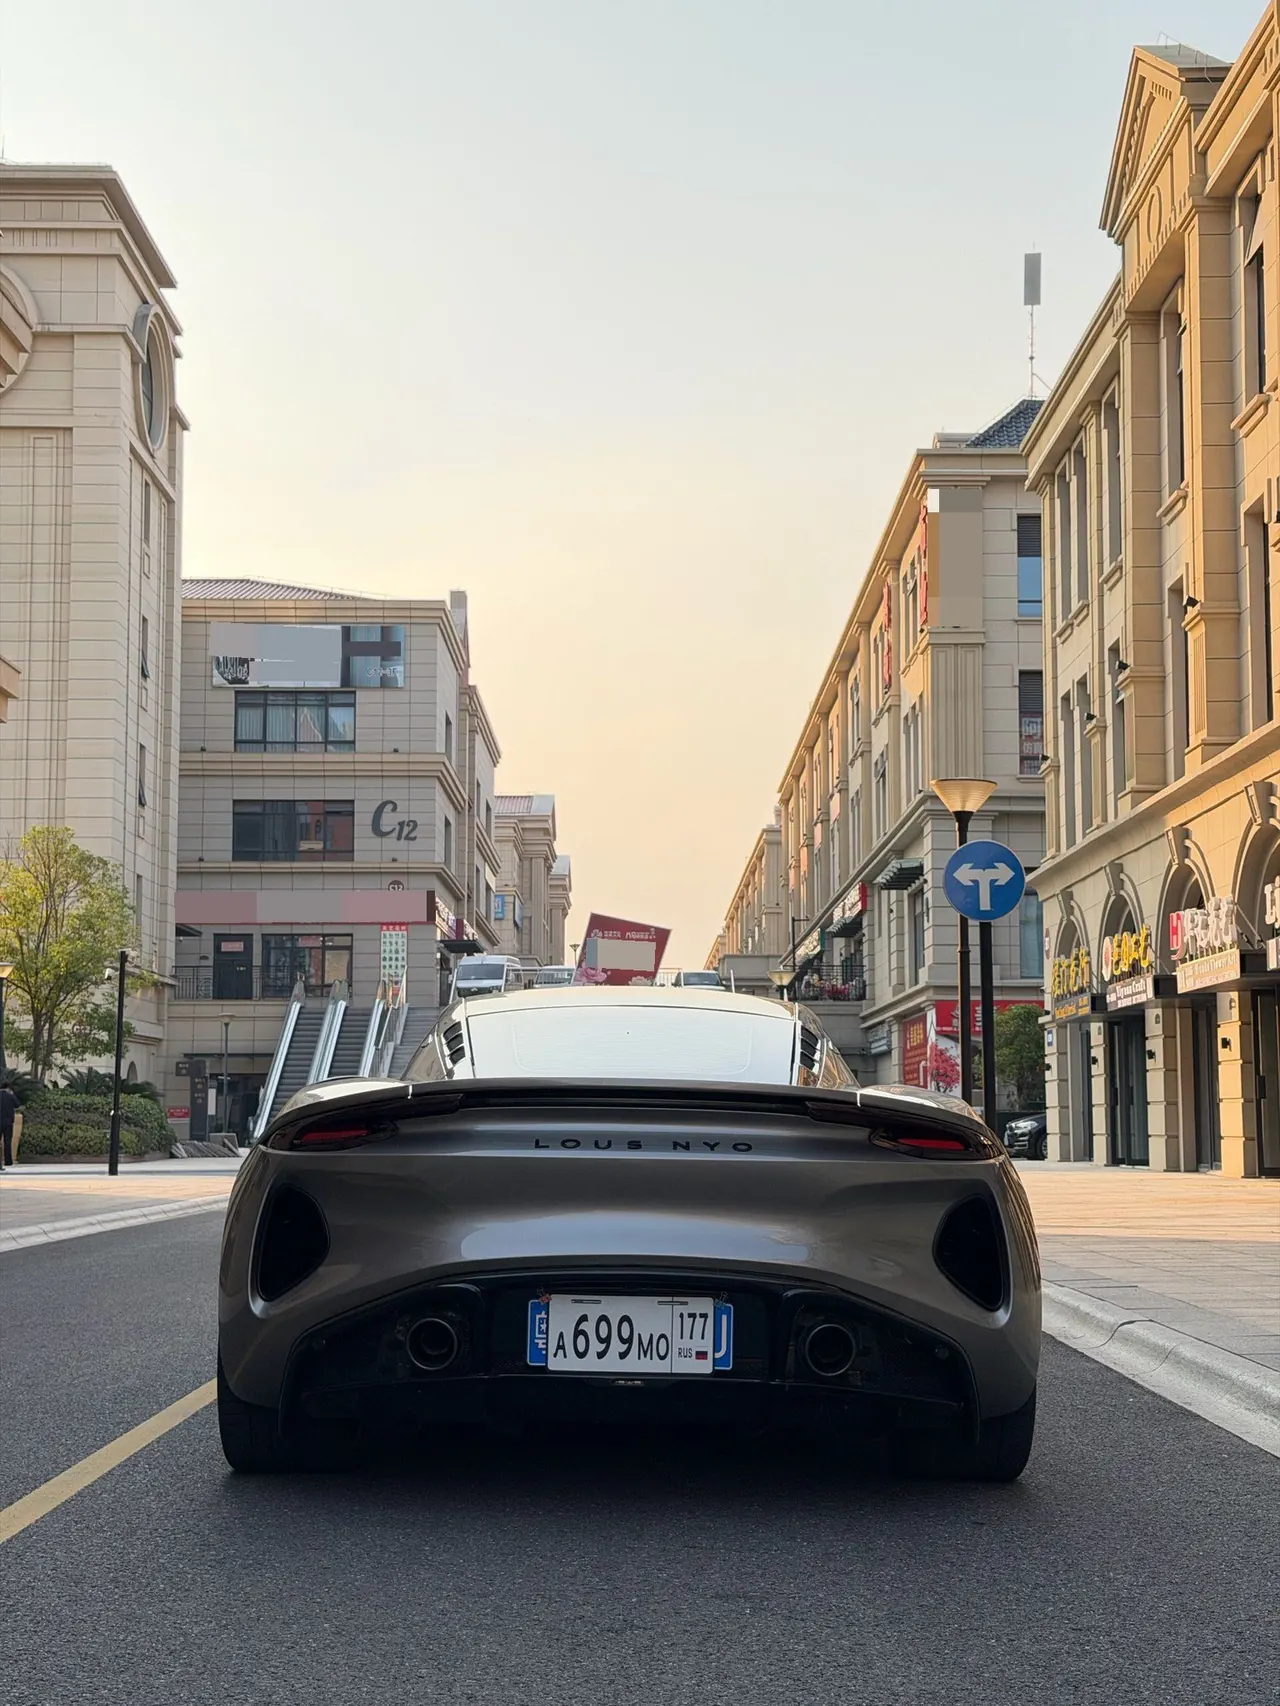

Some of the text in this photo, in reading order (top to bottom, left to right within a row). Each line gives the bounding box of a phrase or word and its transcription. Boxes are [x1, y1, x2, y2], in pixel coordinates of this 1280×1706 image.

[371, 800, 418, 841] C12
[534, 1138, 753, 1152] LOUS NYO
[679, 1312, 709, 1340] 177
[677, 1347, 693, 1359] RUS
